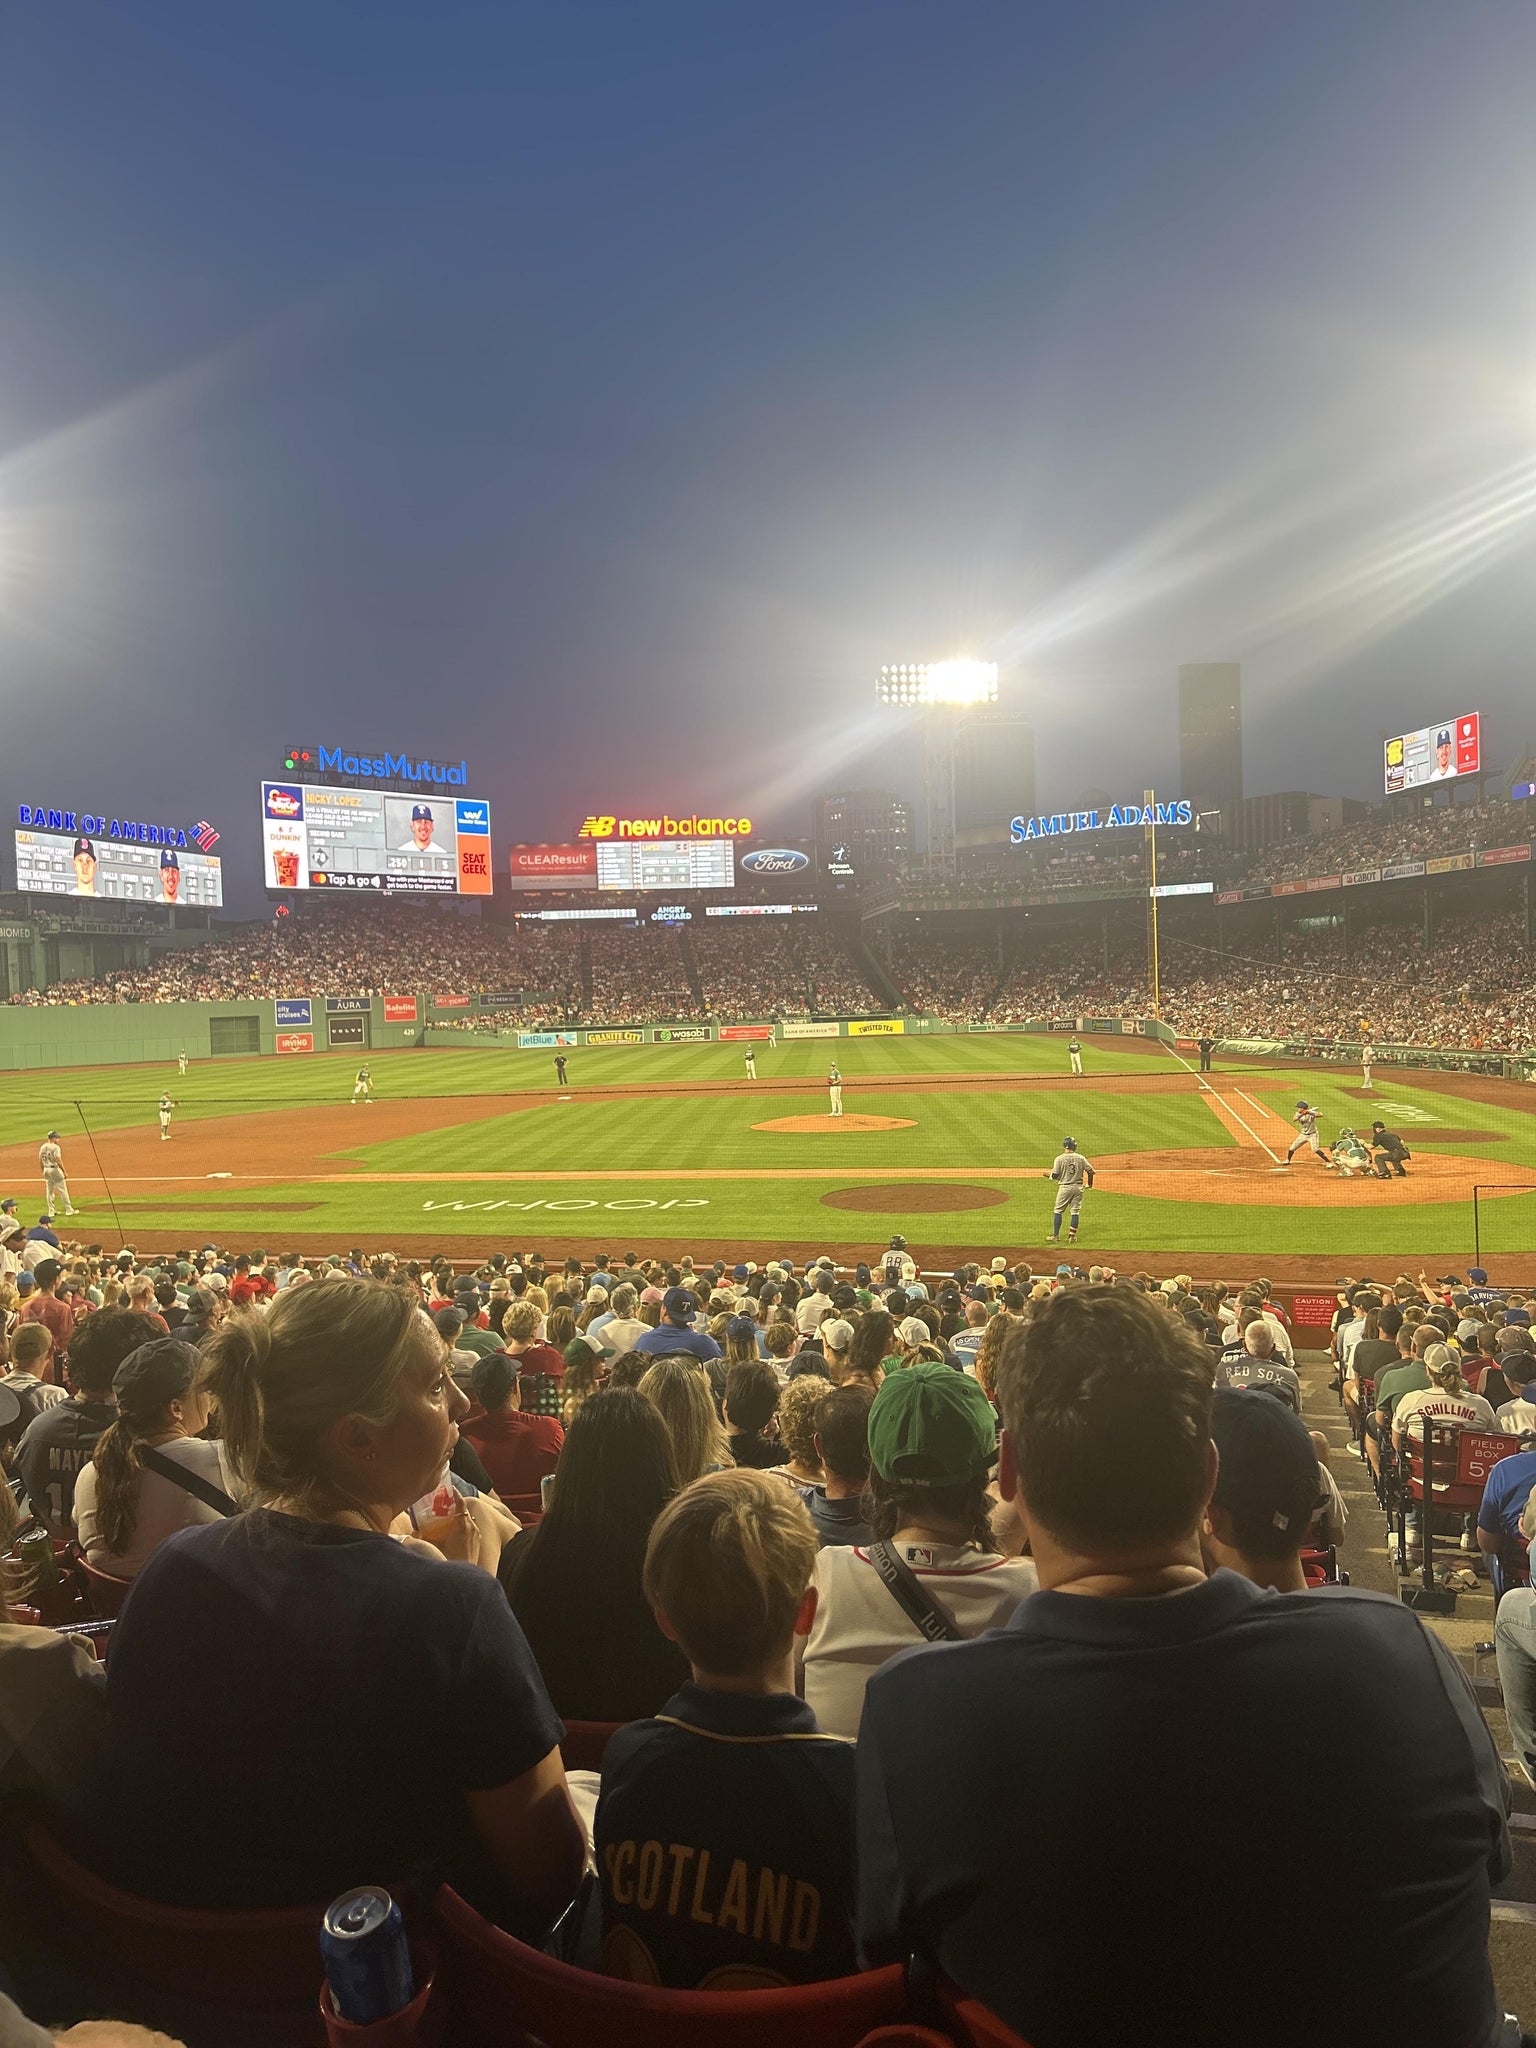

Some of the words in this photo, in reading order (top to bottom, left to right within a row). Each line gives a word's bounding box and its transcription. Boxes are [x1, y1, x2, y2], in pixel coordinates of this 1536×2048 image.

[318, 744, 467, 785] MassMutual
[306, 793, 331, 804] NICKY
[333, 795, 362, 807] LOPEZ
[19, 803, 77, 832] BANK
[81, 814, 106, 836] OF
[109, 818, 188, 848] AMERICA
[619, 819, 661, 837] new
[663, 815, 752, 836] balance
[1010, 810, 1103, 844] SAMUEL
[1105, 800, 1193, 827] ADAMS
[388, 857, 407, 868] .250
[442, 860, 449, 870] 5
[463, 852, 485, 864] SEAT
[518, 854, 589, 865] CLEAResult
[754, 851, 796, 871] Ford
[462, 864, 487, 875] GEEK
[831, 868, 854, 876] Controls
[327, 874, 346, 887] Tap
[347, 874, 356, 885] &
[356, 877, 370, 887] go
[108, 882, 113, 895] 1
[126, 884, 133, 897] 2
[144, 885, 152, 899] 2
[657, 906, 686, 914] ANGRY
[650, 912, 692, 921] ORCHARD
[277, 1006, 290, 1014] city
[277, 1011, 301, 1019] cruises
[859, 1024, 882, 1034] TWISTED
[883, 1024, 894, 1033] TEA
[916, 1019, 929, 1028] 380
[588, 1032, 624, 1044] GRANITE
[624, 1030, 642, 1043] CITY
[672, 1028, 704, 1038] wasabi
[282, 1038, 308, 1047] IRVING
[522, 1035, 552, 1046] jetBlue
[1069, 1163, 1076, 1175] 3
[422, 1199, 710, 1211] WHOOP
[682, 1301, 691, 1312] T
[1225, 1365, 1250, 1378] RED
[1257, 1368, 1285, 1386] SOX
[1417, 1403, 1476, 1421] SCHILLING
[1470, 1439, 1505, 1450] FIELD
[1474, 1449, 1500, 1459] BOX
[1468, 1461, 1495, 1478] 5
